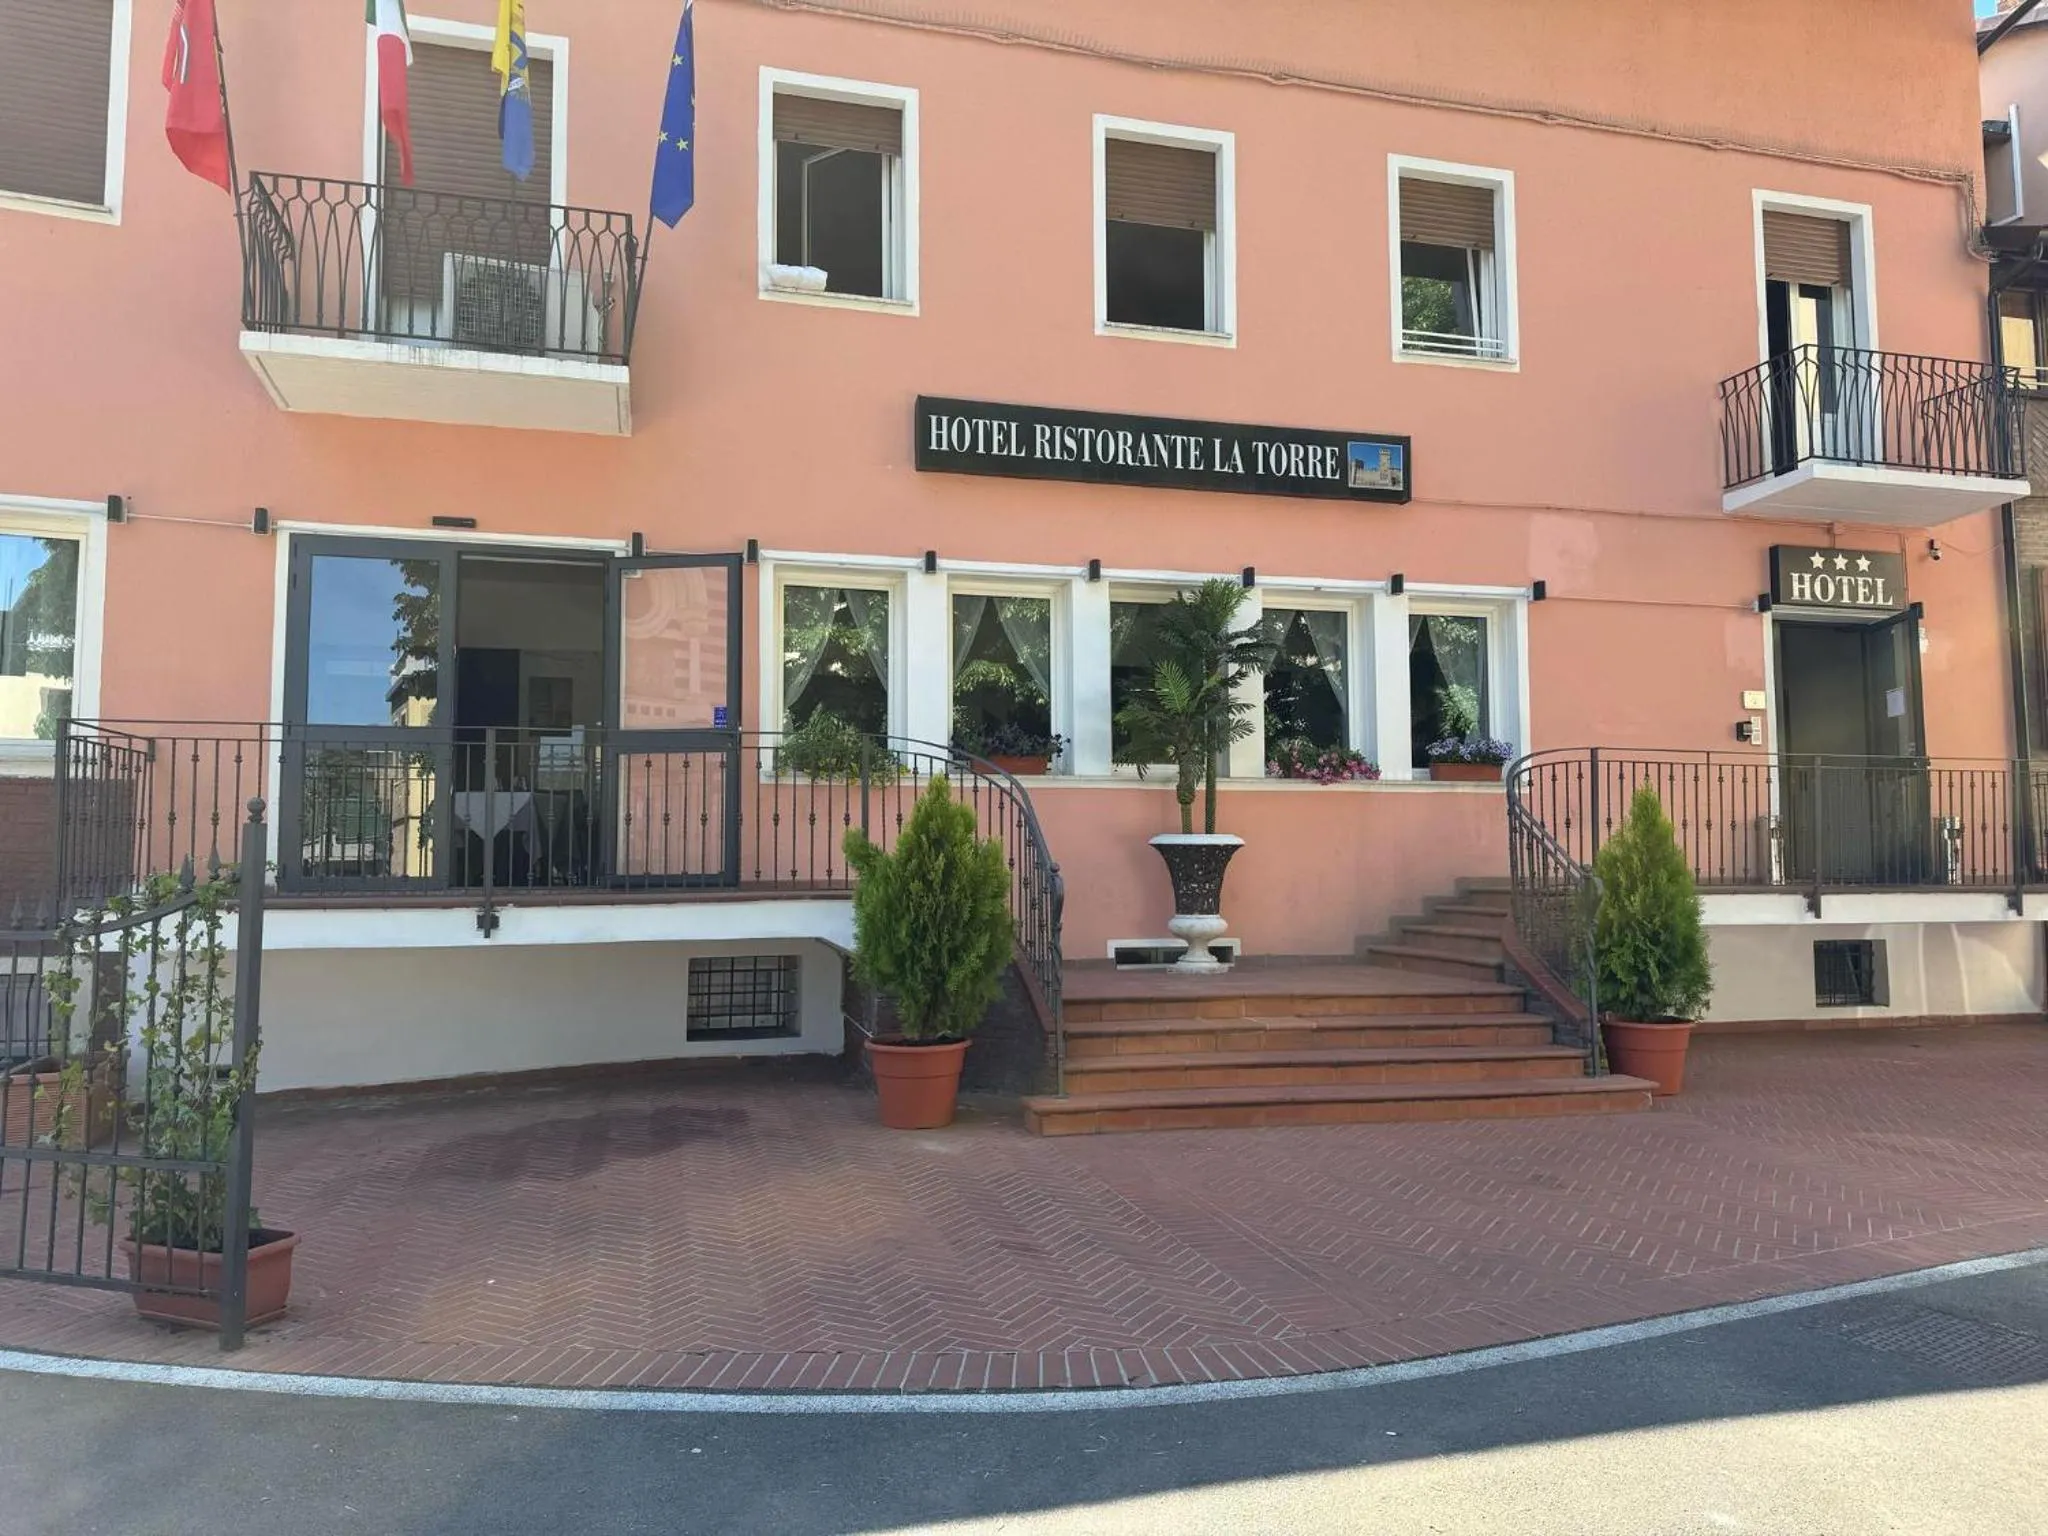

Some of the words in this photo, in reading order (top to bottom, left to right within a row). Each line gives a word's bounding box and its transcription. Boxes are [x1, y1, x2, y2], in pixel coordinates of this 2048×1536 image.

[928, 414, 1026, 457] HOTEL
[1033, 424, 1204, 471] RISTORANTE
[1212, 438, 1245, 473] LA
[1252, 441, 1340, 480] TORRE
[1789, 572, 1893, 606] HOTEL
